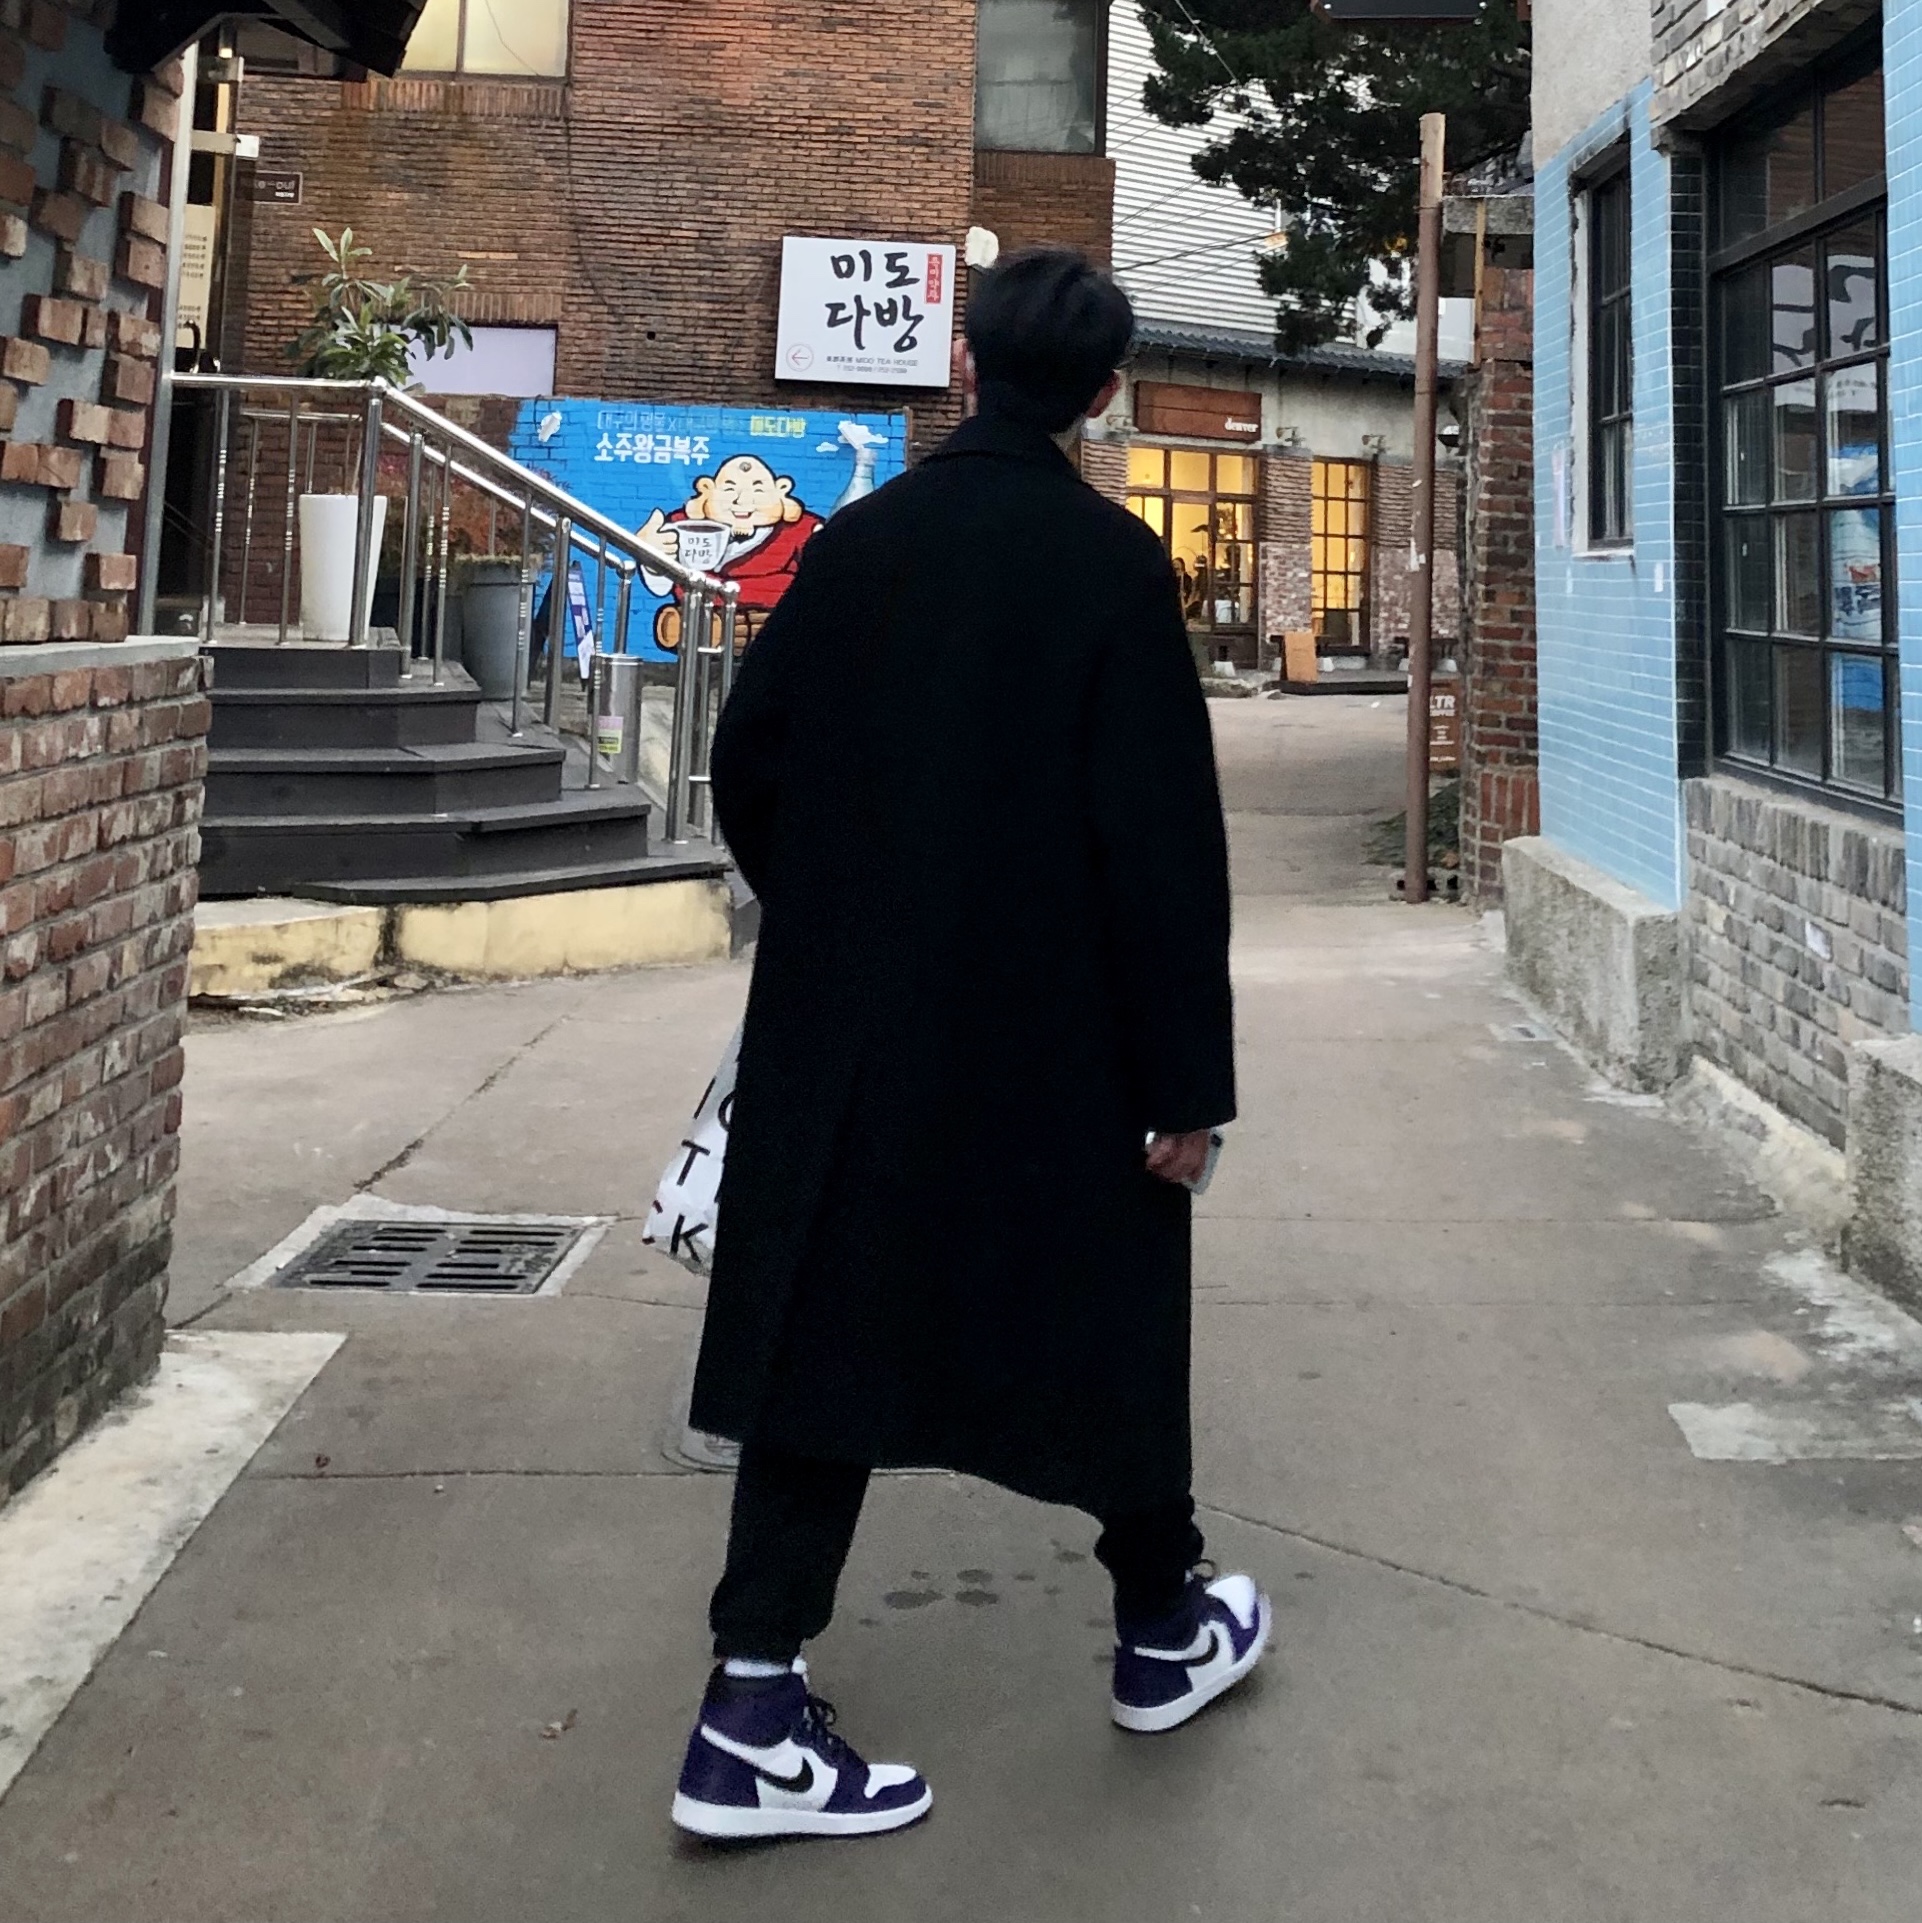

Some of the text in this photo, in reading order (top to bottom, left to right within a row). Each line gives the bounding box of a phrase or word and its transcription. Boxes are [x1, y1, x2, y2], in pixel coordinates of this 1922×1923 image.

[830, 249, 921, 289] 미도
[824, 294, 925, 353] 다방
[750, 414, 807, 439] 미도다방
[593, 432, 711, 466] 소주왕금복주
[685, 548, 713, 565] 다방
[687, 536, 712, 548] 미도
